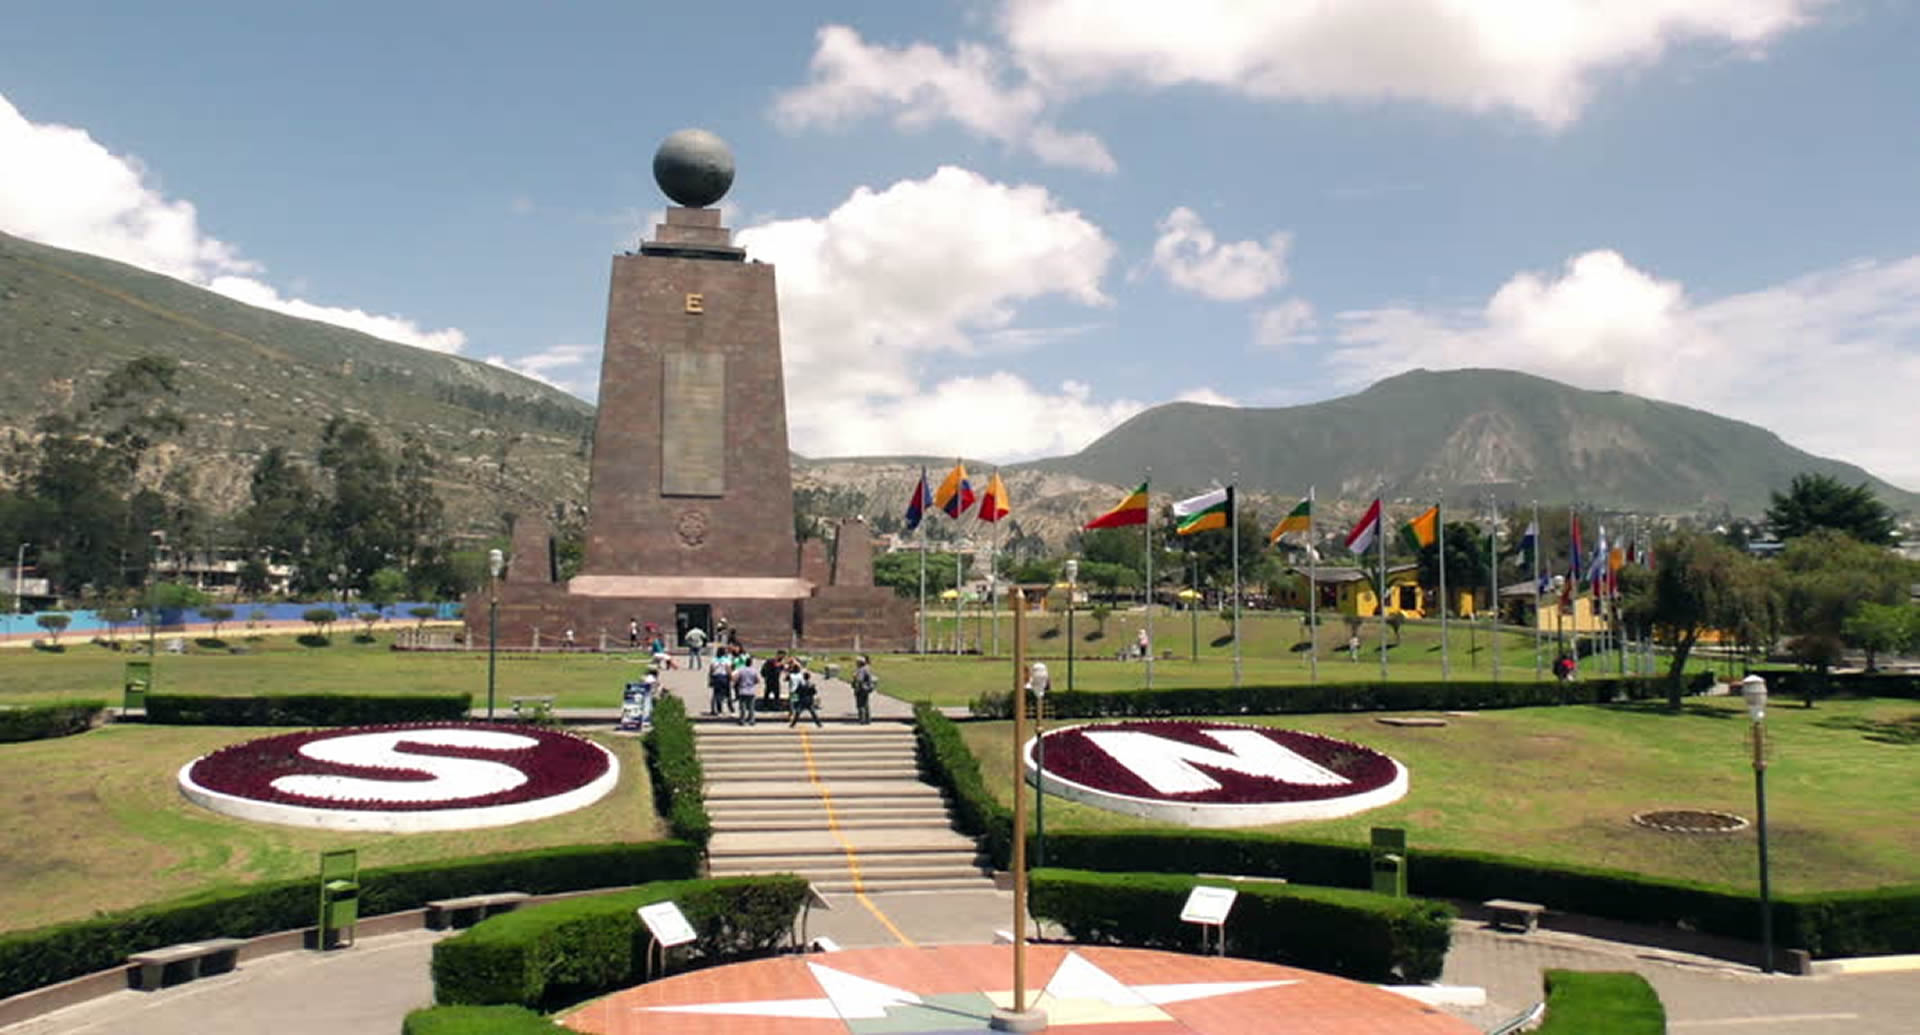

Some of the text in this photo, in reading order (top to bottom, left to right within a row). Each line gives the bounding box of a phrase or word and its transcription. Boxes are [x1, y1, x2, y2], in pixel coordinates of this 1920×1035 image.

[685, 293, 704, 312] E
[270, 729, 540, 802] S
[1080, 729, 1353, 795] N
